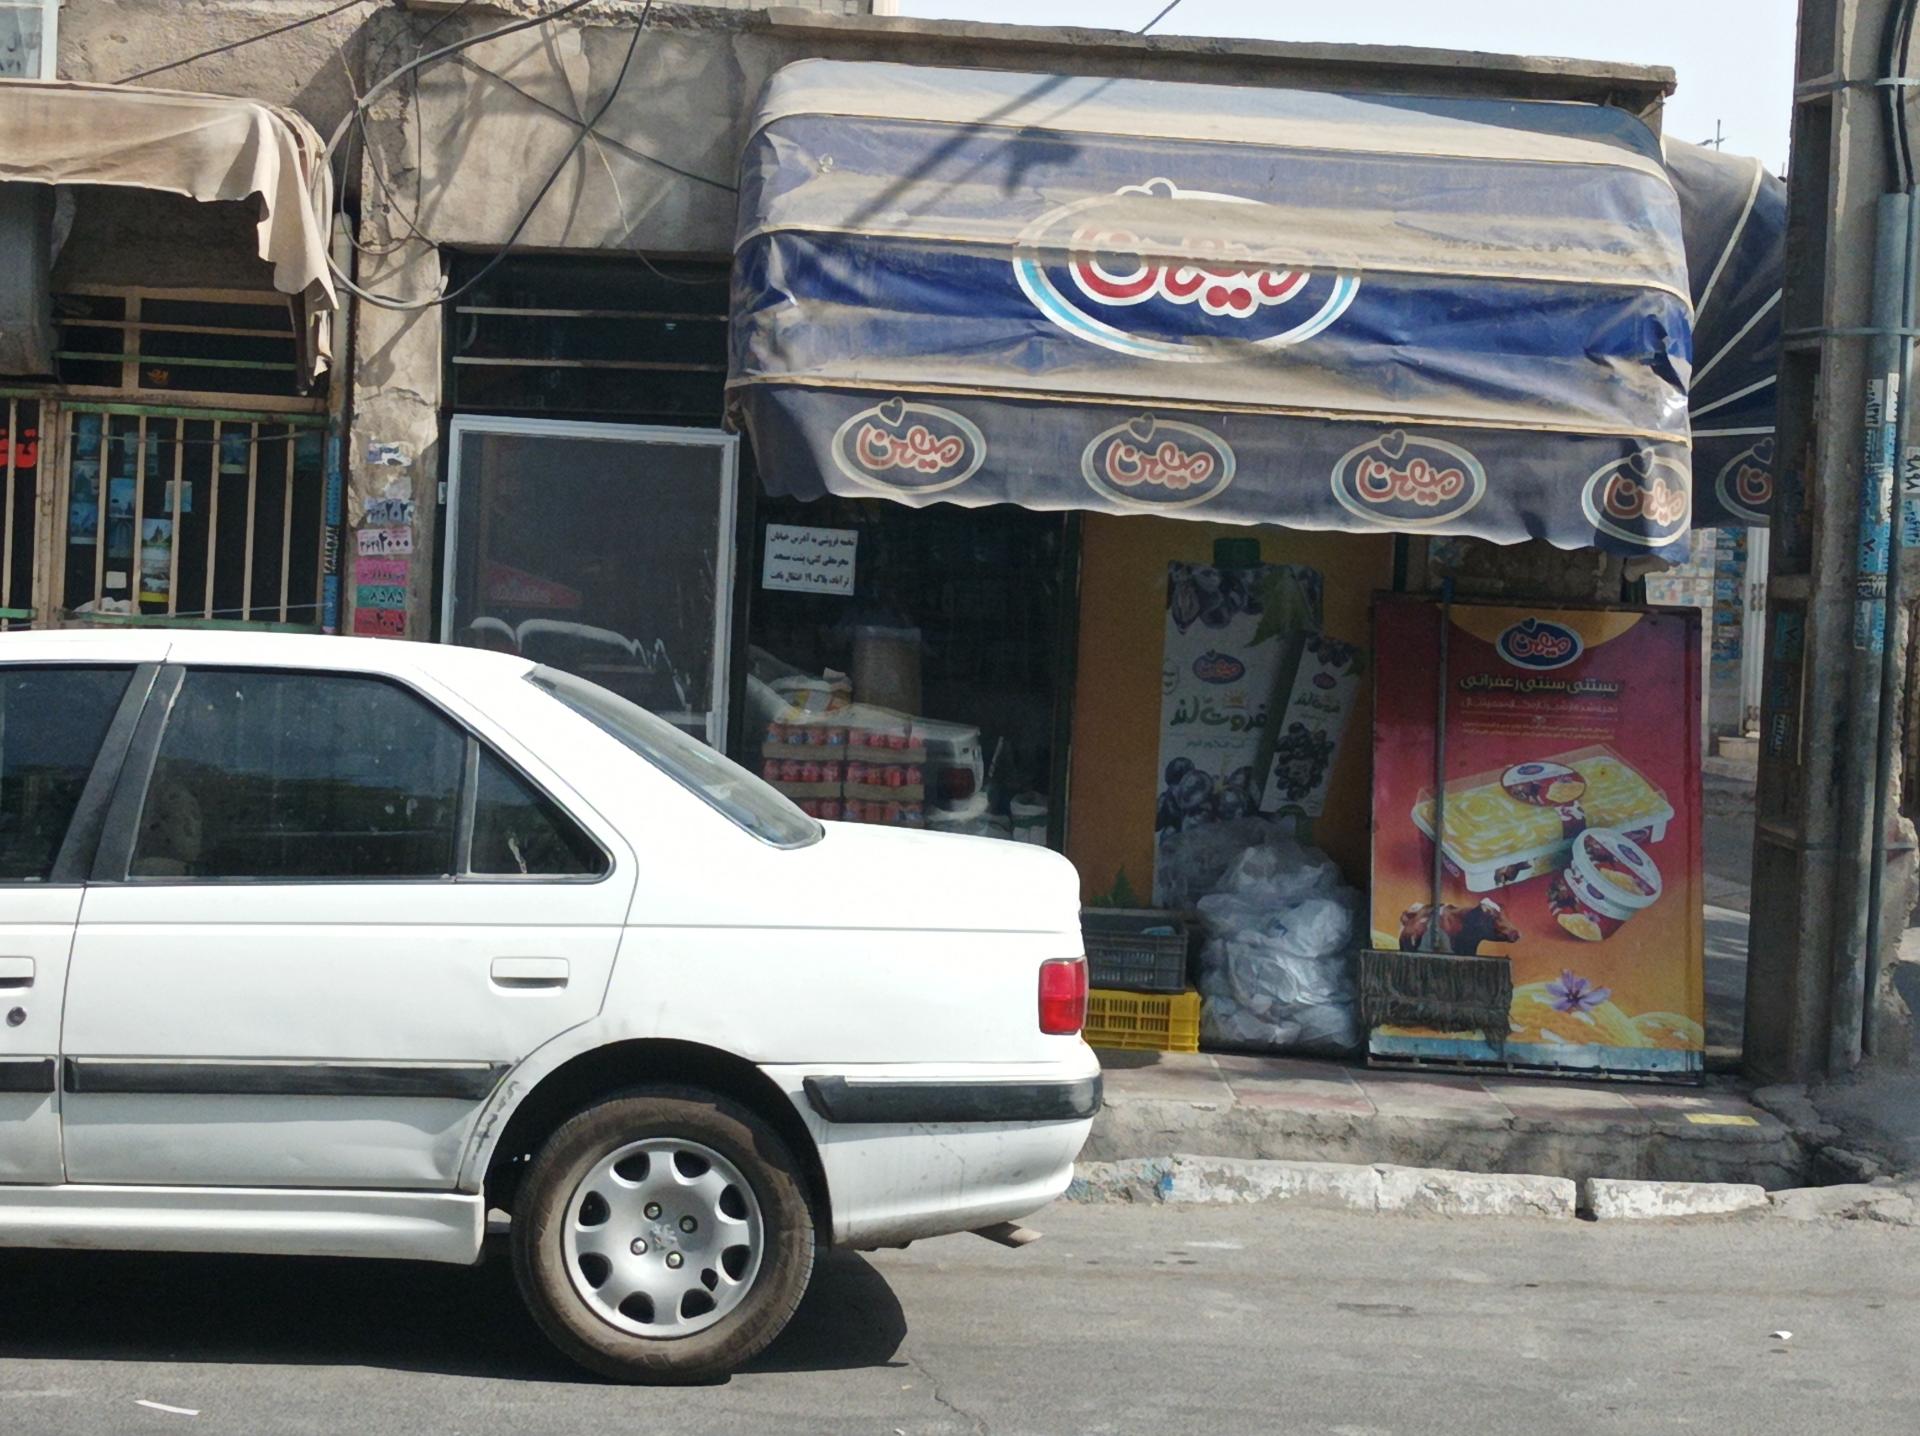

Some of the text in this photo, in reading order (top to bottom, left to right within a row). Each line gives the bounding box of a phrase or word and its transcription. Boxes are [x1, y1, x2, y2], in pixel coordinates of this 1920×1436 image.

[856, 424, 965, 474] میهن
[1105, 438, 1214, 490] میهن
[1355, 454, 1465, 507] میهن
[1603, 472, 1688, 528] میهن
[1507, 630, 1572, 658] میهن
[1459, 673, 1619, 697] بستنی سنتی زعفرانی
[1169, 696, 1268, 733] فروت لند
